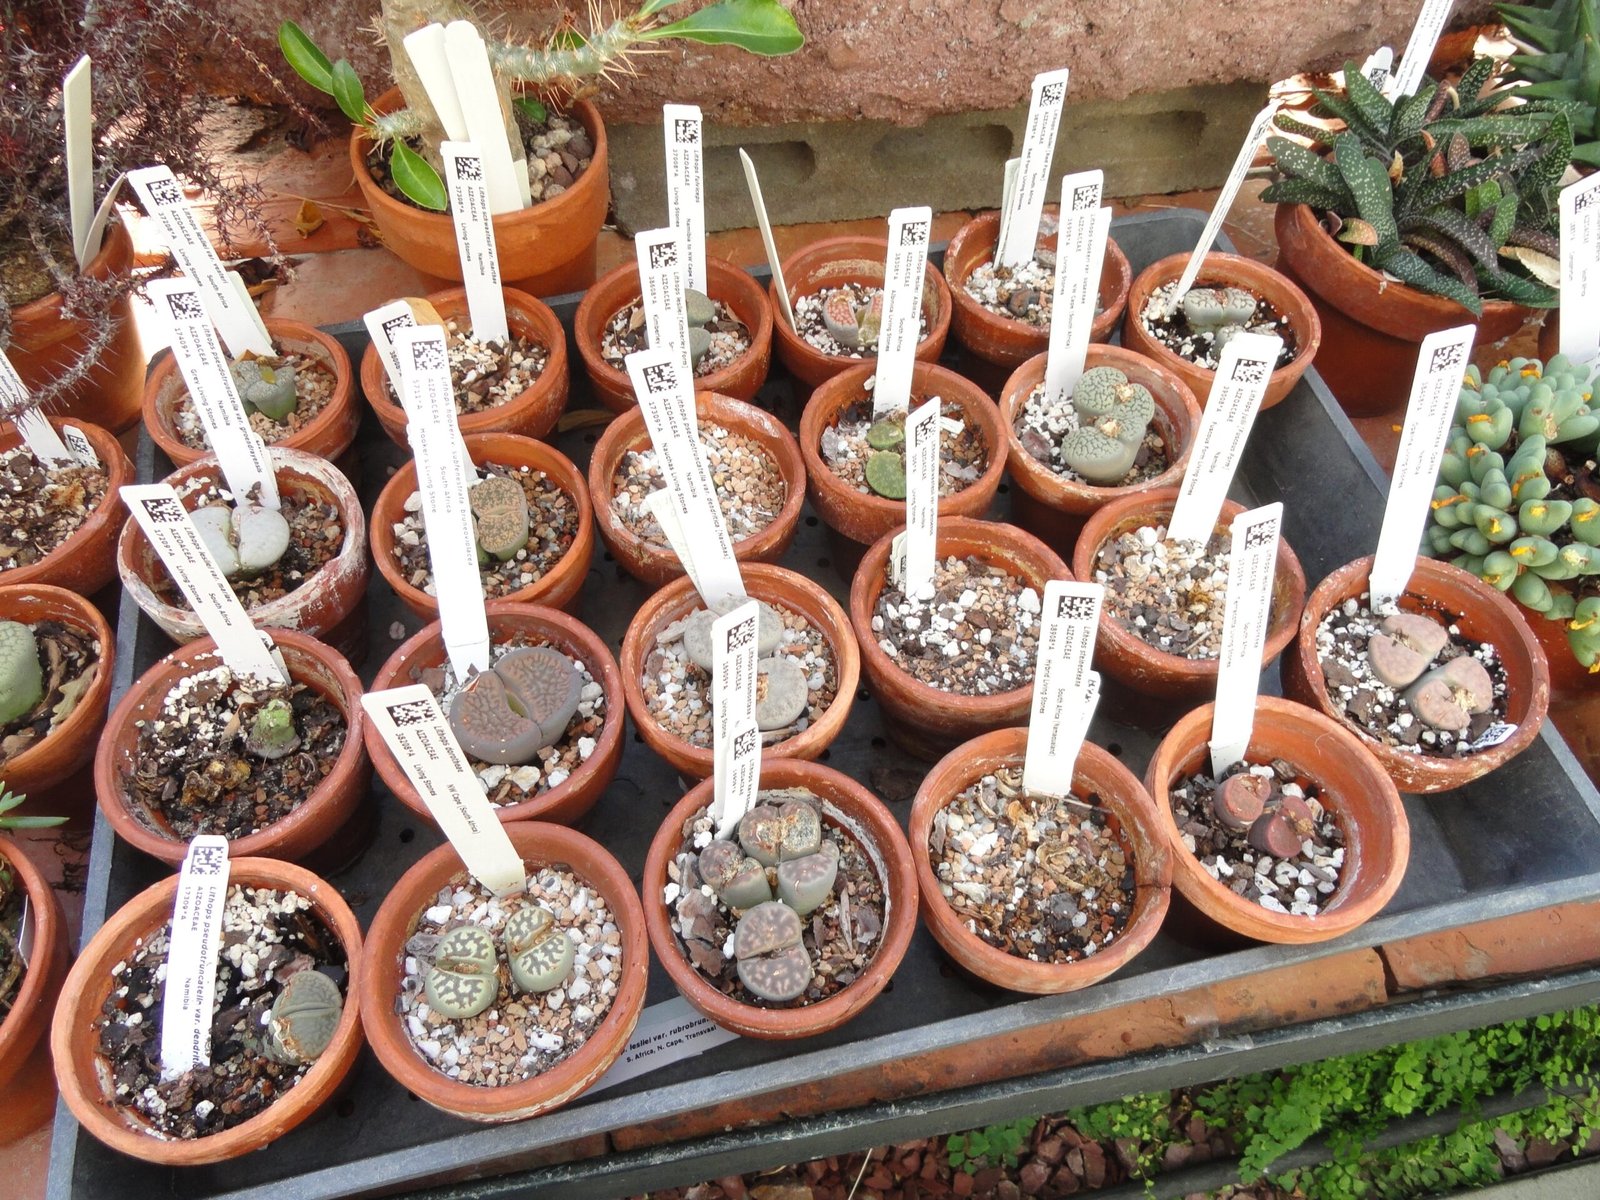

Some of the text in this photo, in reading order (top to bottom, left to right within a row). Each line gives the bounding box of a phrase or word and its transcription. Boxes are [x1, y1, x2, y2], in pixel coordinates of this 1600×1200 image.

[468, 186, 478, 222] AIZOACEAE
[478, 186, 486, 210] Lithops
[182, 208, 198, 231] Lithops
[195, 232, 210, 250] lesliei
[206, 250, 215, 260] var.
[170, 210, 228, 309] AIZOACEAE South Africa
[178, 248, 192, 267] Living
[189, 267, 203, 287] Stones
[189, 326, 230, 426] AIZOACEAE Namibia
[201, 324, 216, 350] Lithops
[211, 352, 239, 411] pseudotruncatella
[236, 413, 244, 425] var.
[441, 376, 450, 406] Lithops
[190, 369, 200, 384] Grey
[197, 386, 209, 406] Living
[205, 407, 218, 430] Stones
[1244, 390, 1256, 412] Lithops
[428, 378, 440, 424] AIZOACEAE
[440, 466, 448, 489] South
[663, 398, 697, 498] AIZOACEAE Namibia
[1208, 388, 1244, 473] AIZOACEAE Namibia
[425, 465, 433, 489] Living
[662, 442, 674, 471] Nauchas
[670, 472, 681, 492] Living
[678, 493, 688, 514] Stones
[675, 395, 688, 421] Lithops
[683, 423, 706, 482] pseudotruncatella
[706, 497, 720, 528] dendritica
[1192, 461, 1203, 478] Living
[1187, 478, 1198, 496] Stones
[169, 528, 232, 626] AIZOACEAE South Africa
[184, 527, 232, 602] Lithops lesliei var. mariae
[176, 565, 190, 583] Living
[188, 584, 203, 604] Stones
[1063, 625, 1075, 659] AIZOACEAE
[1080, 626, 1090, 649] Lithops
[1039, 696, 1048, 714] Stones
[1040, 679, 1050, 695] Living
[1056, 688, 1066, 704] South
[1054, 704, 1063, 720] Africa
[433, 726, 464, 773] Lithops dorotheae
[413, 764, 427, 780] Living
[423, 780, 437, 796] Stones
[416, 729, 439, 760] AIZOACEAE
[447, 784, 457, 793] NW
[452, 793, 462, 805] Cape
[457, 805, 472, 820] (South
[205, 886, 216, 920] Lithops
[182, 886, 203, 1010] AIZOACEAE Namibia
[196, 922, 210, 1005] pseudotruncatell
[630, 1036, 651, 1050] lesliei
[653, 1032, 667, 1041] var.
[635, 1048, 655, 1059] Africa,
[666, 1038, 684, 1048] Cape,
[685, 1024, 716, 1040] Transvaal
